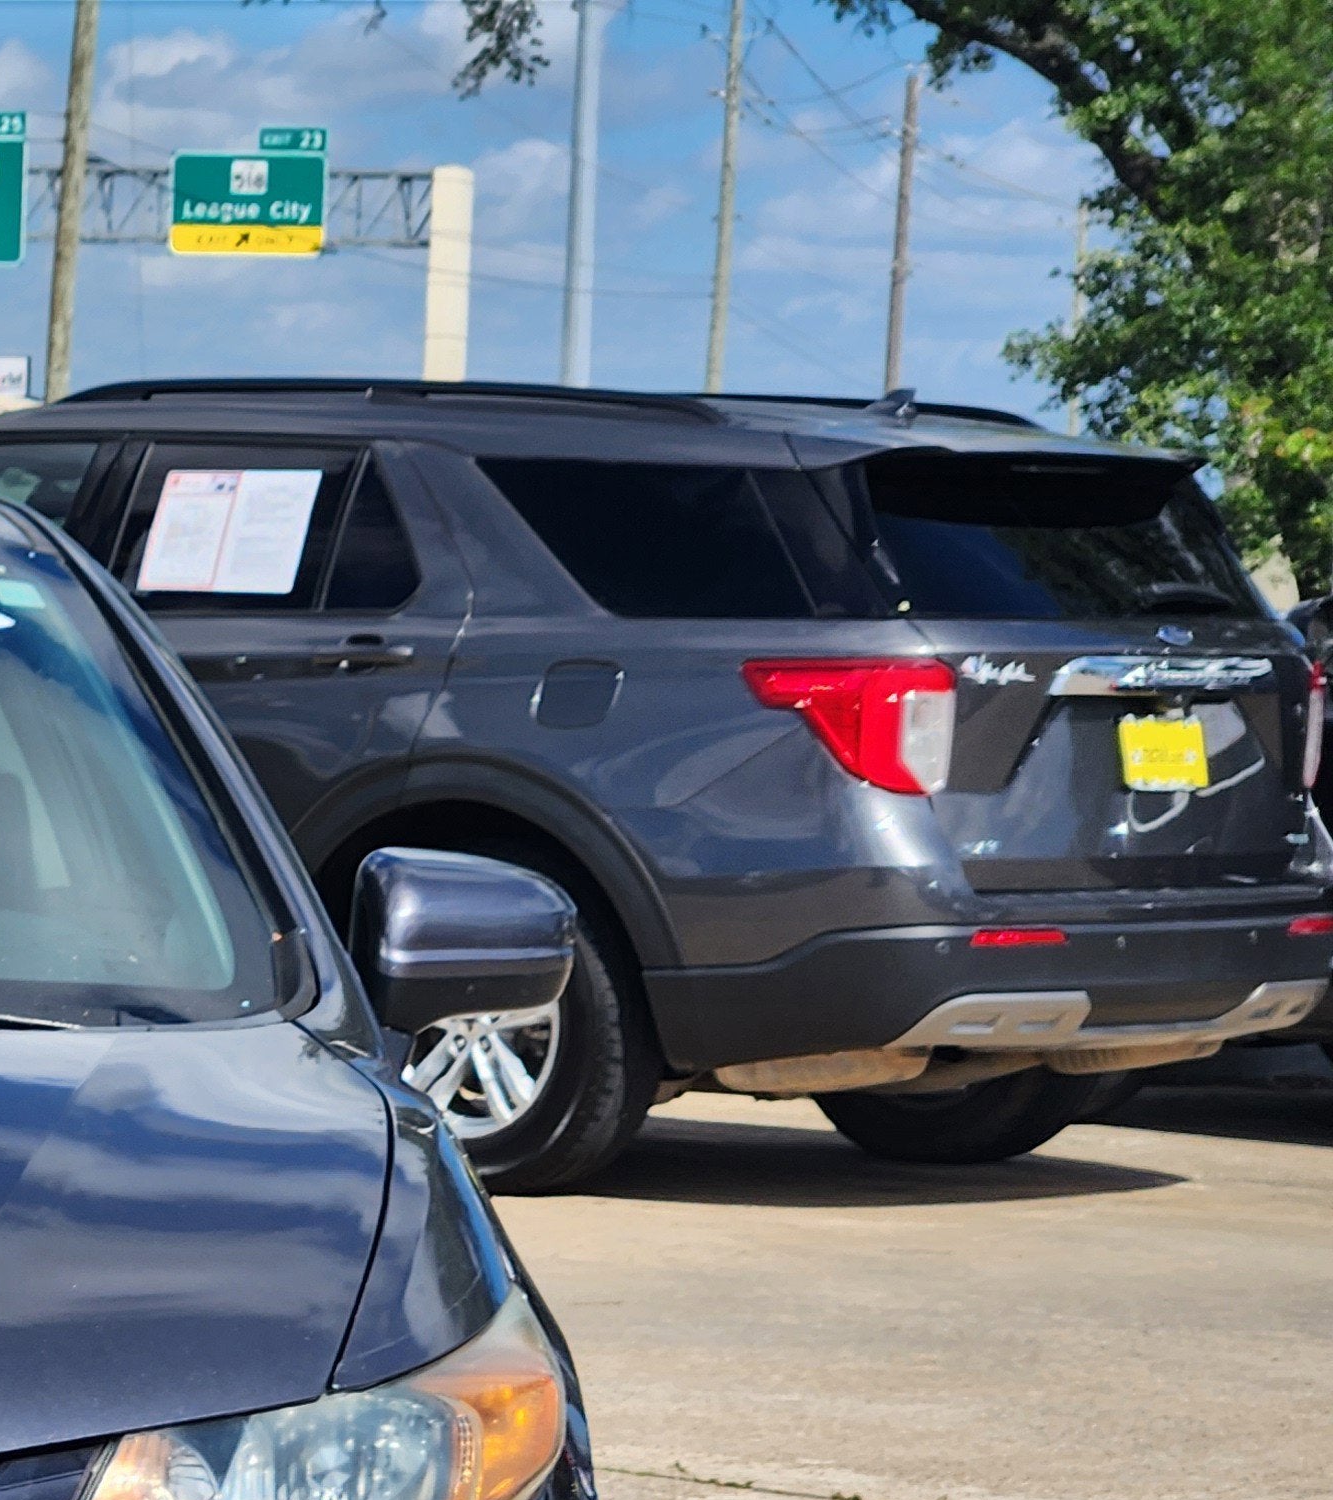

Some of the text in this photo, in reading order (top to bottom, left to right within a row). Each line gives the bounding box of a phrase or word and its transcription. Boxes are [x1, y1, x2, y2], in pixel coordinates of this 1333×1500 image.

[300, 131, 323, 149] 23
[182, 199, 312, 224] League City
